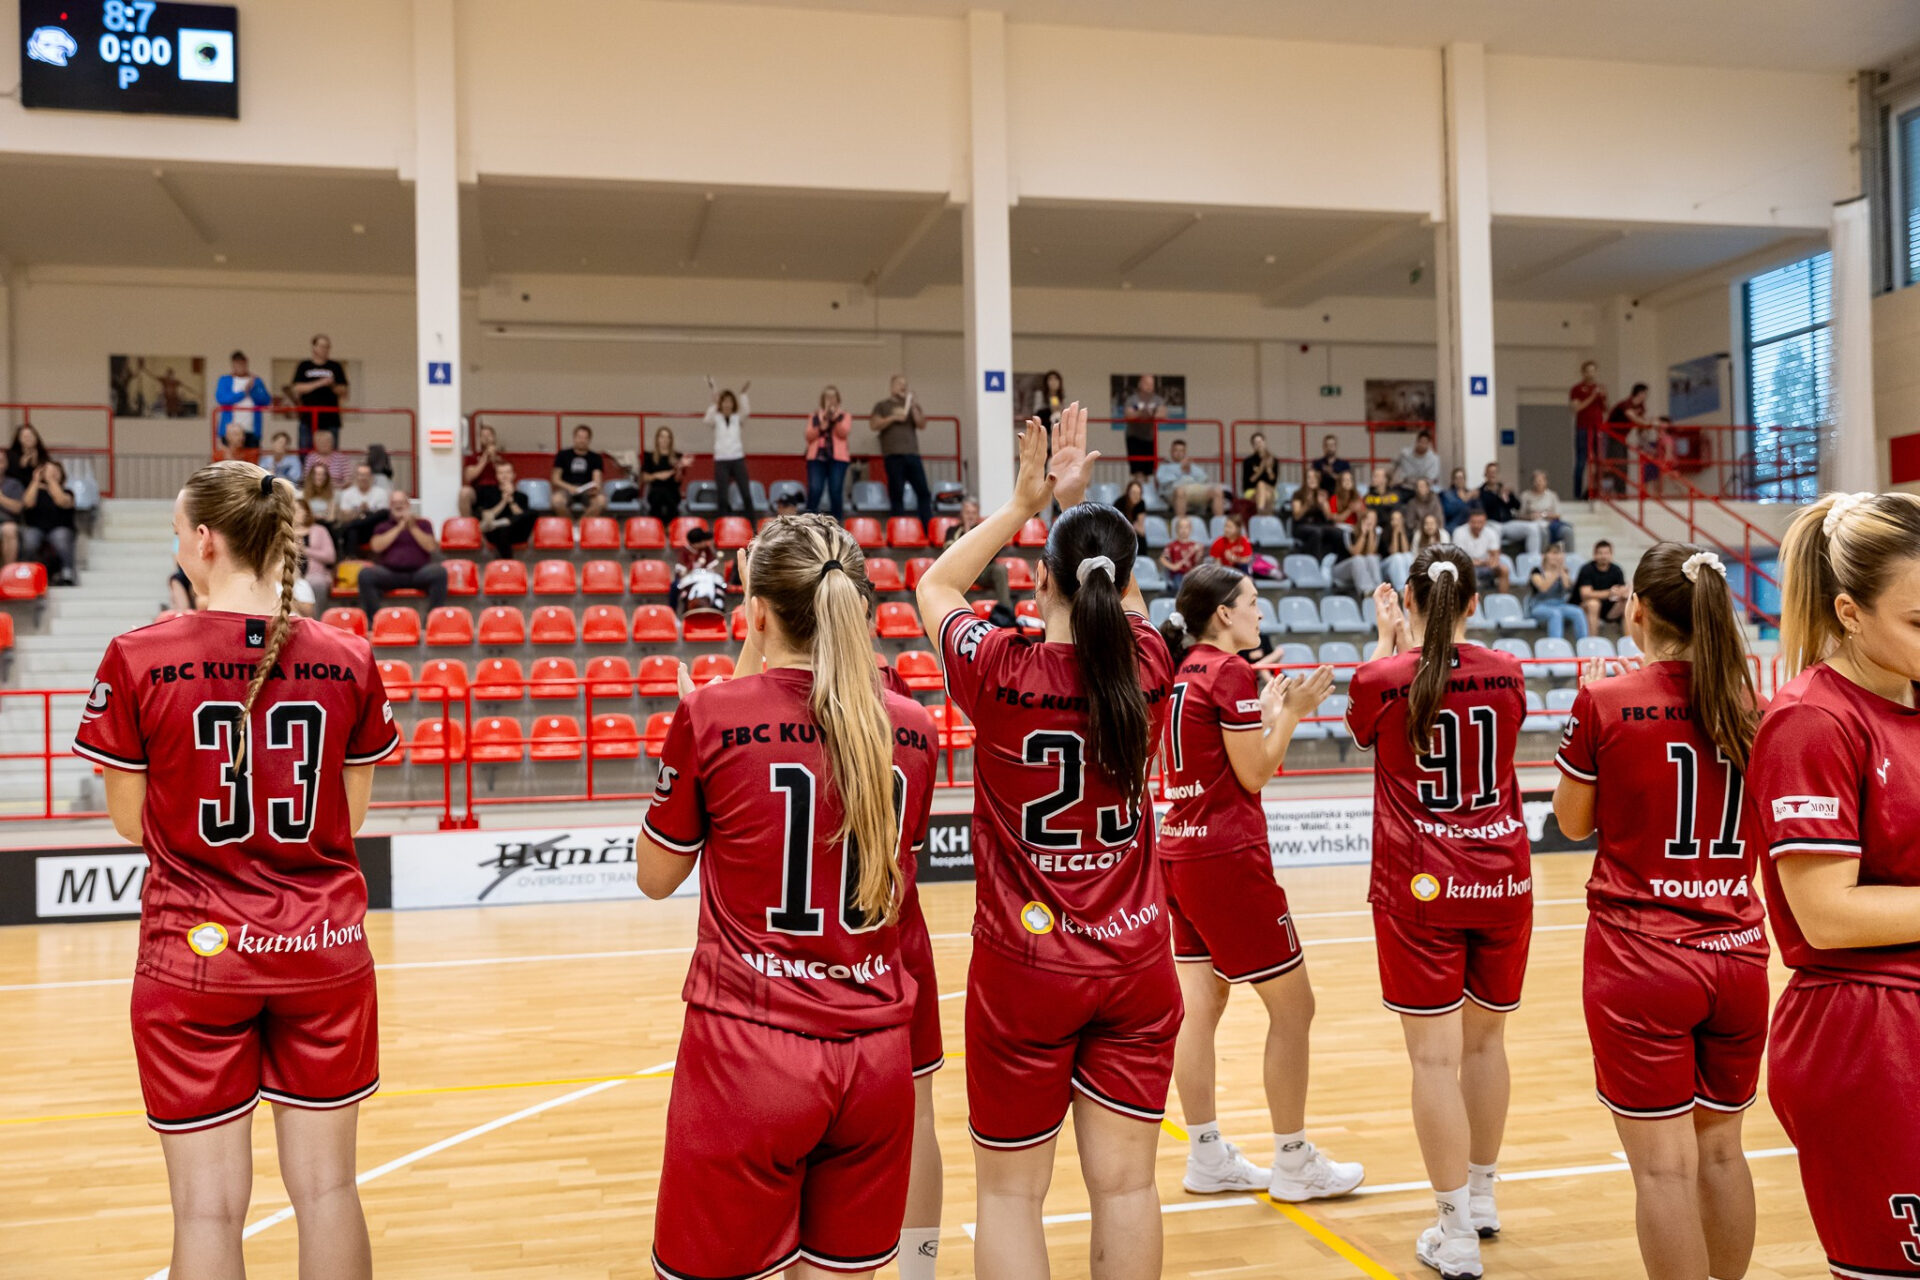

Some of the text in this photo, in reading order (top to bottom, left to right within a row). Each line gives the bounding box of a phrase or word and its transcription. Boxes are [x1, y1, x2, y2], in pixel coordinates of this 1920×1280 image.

[102, 0, 156, 33] 8:7
[99, 33, 172, 66] 0:00
[118, 65, 140, 90] P
[150, 662, 195, 686] FBC
[294, 663, 358, 684] HORA
[996, 687, 1035, 709] FBC
[1621, 706, 1659, 721] FBC
[722, 724, 771, 749] FBC
[893, 727, 929, 754] ORA
[1415, 705, 1501, 812] 91
[192, 701, 327, 847] 33
[1665, 742, 1746, 860] 11
[930, 826, 969, 853] KH
[1445, 876, 1504, 899] kutná
[1649, 874, 1749, 899] TOULOVÁ
[236, 918, 364, 955] kutná hora
[1729, 926, 1762, 949] hora
[741, 952, 875, 984] NĚMCOVÁ
